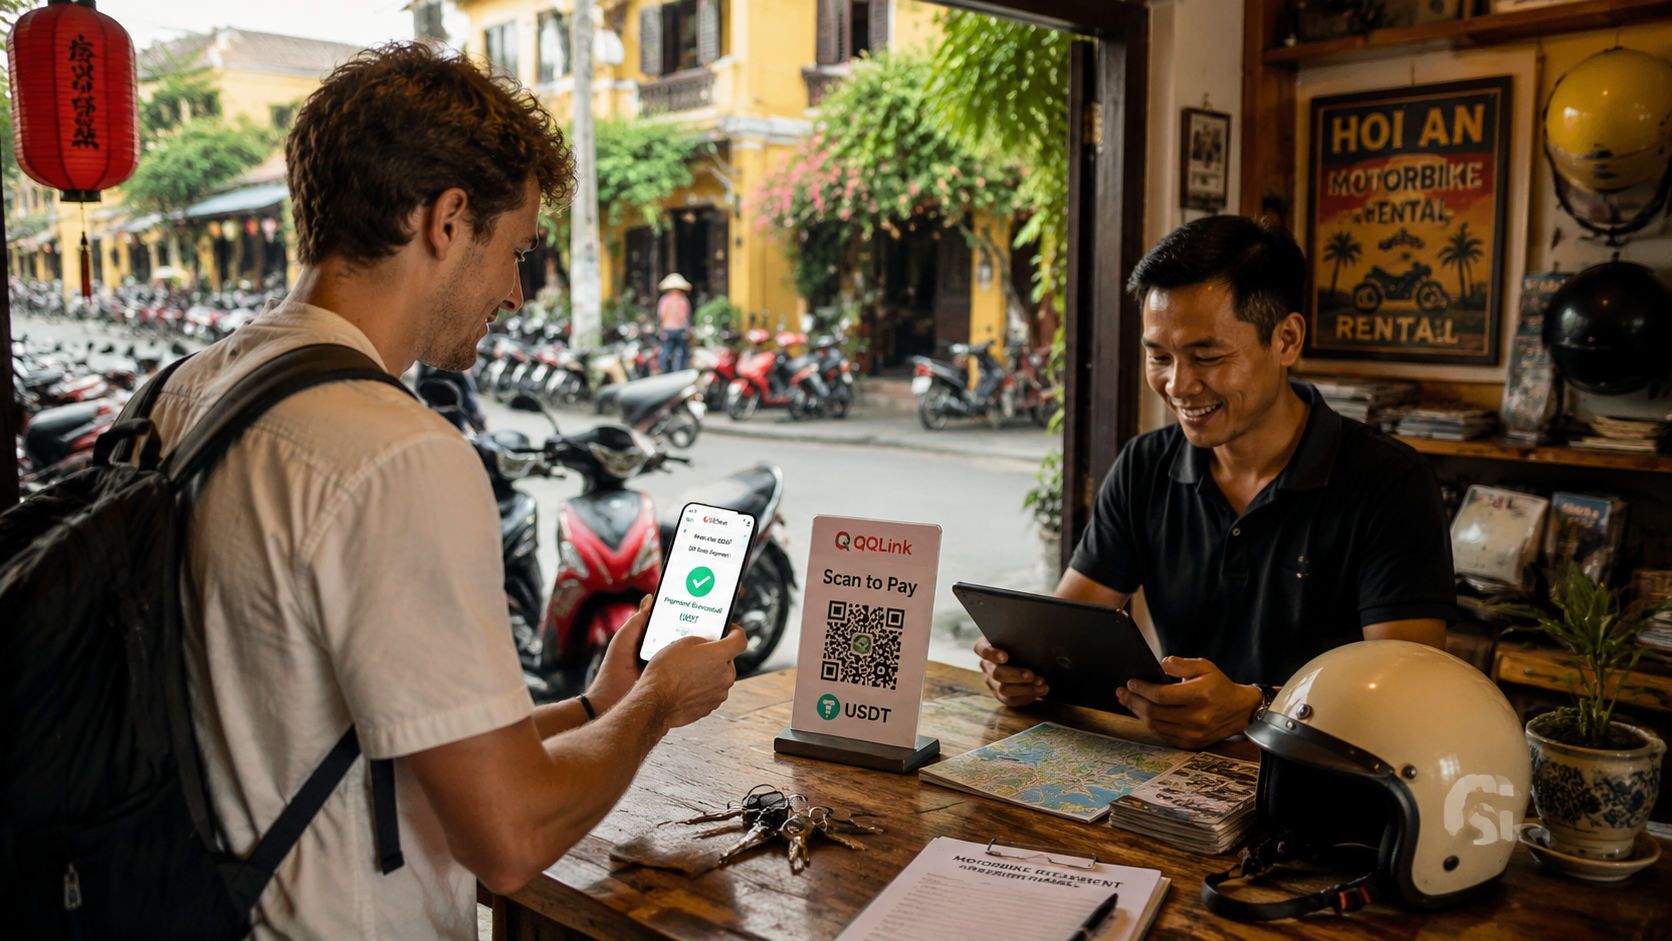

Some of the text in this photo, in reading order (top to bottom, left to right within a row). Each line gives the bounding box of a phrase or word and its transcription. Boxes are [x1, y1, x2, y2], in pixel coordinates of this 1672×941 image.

[1332, 104, 1485, 153] HOI AN
[1328, 162, 1483, 197] MOTORBIKE
[854, 535, 912, 555] QQLink
[823, 569, 918, 598] Scan to Pay
[845, 703, 892, 723] USDT
